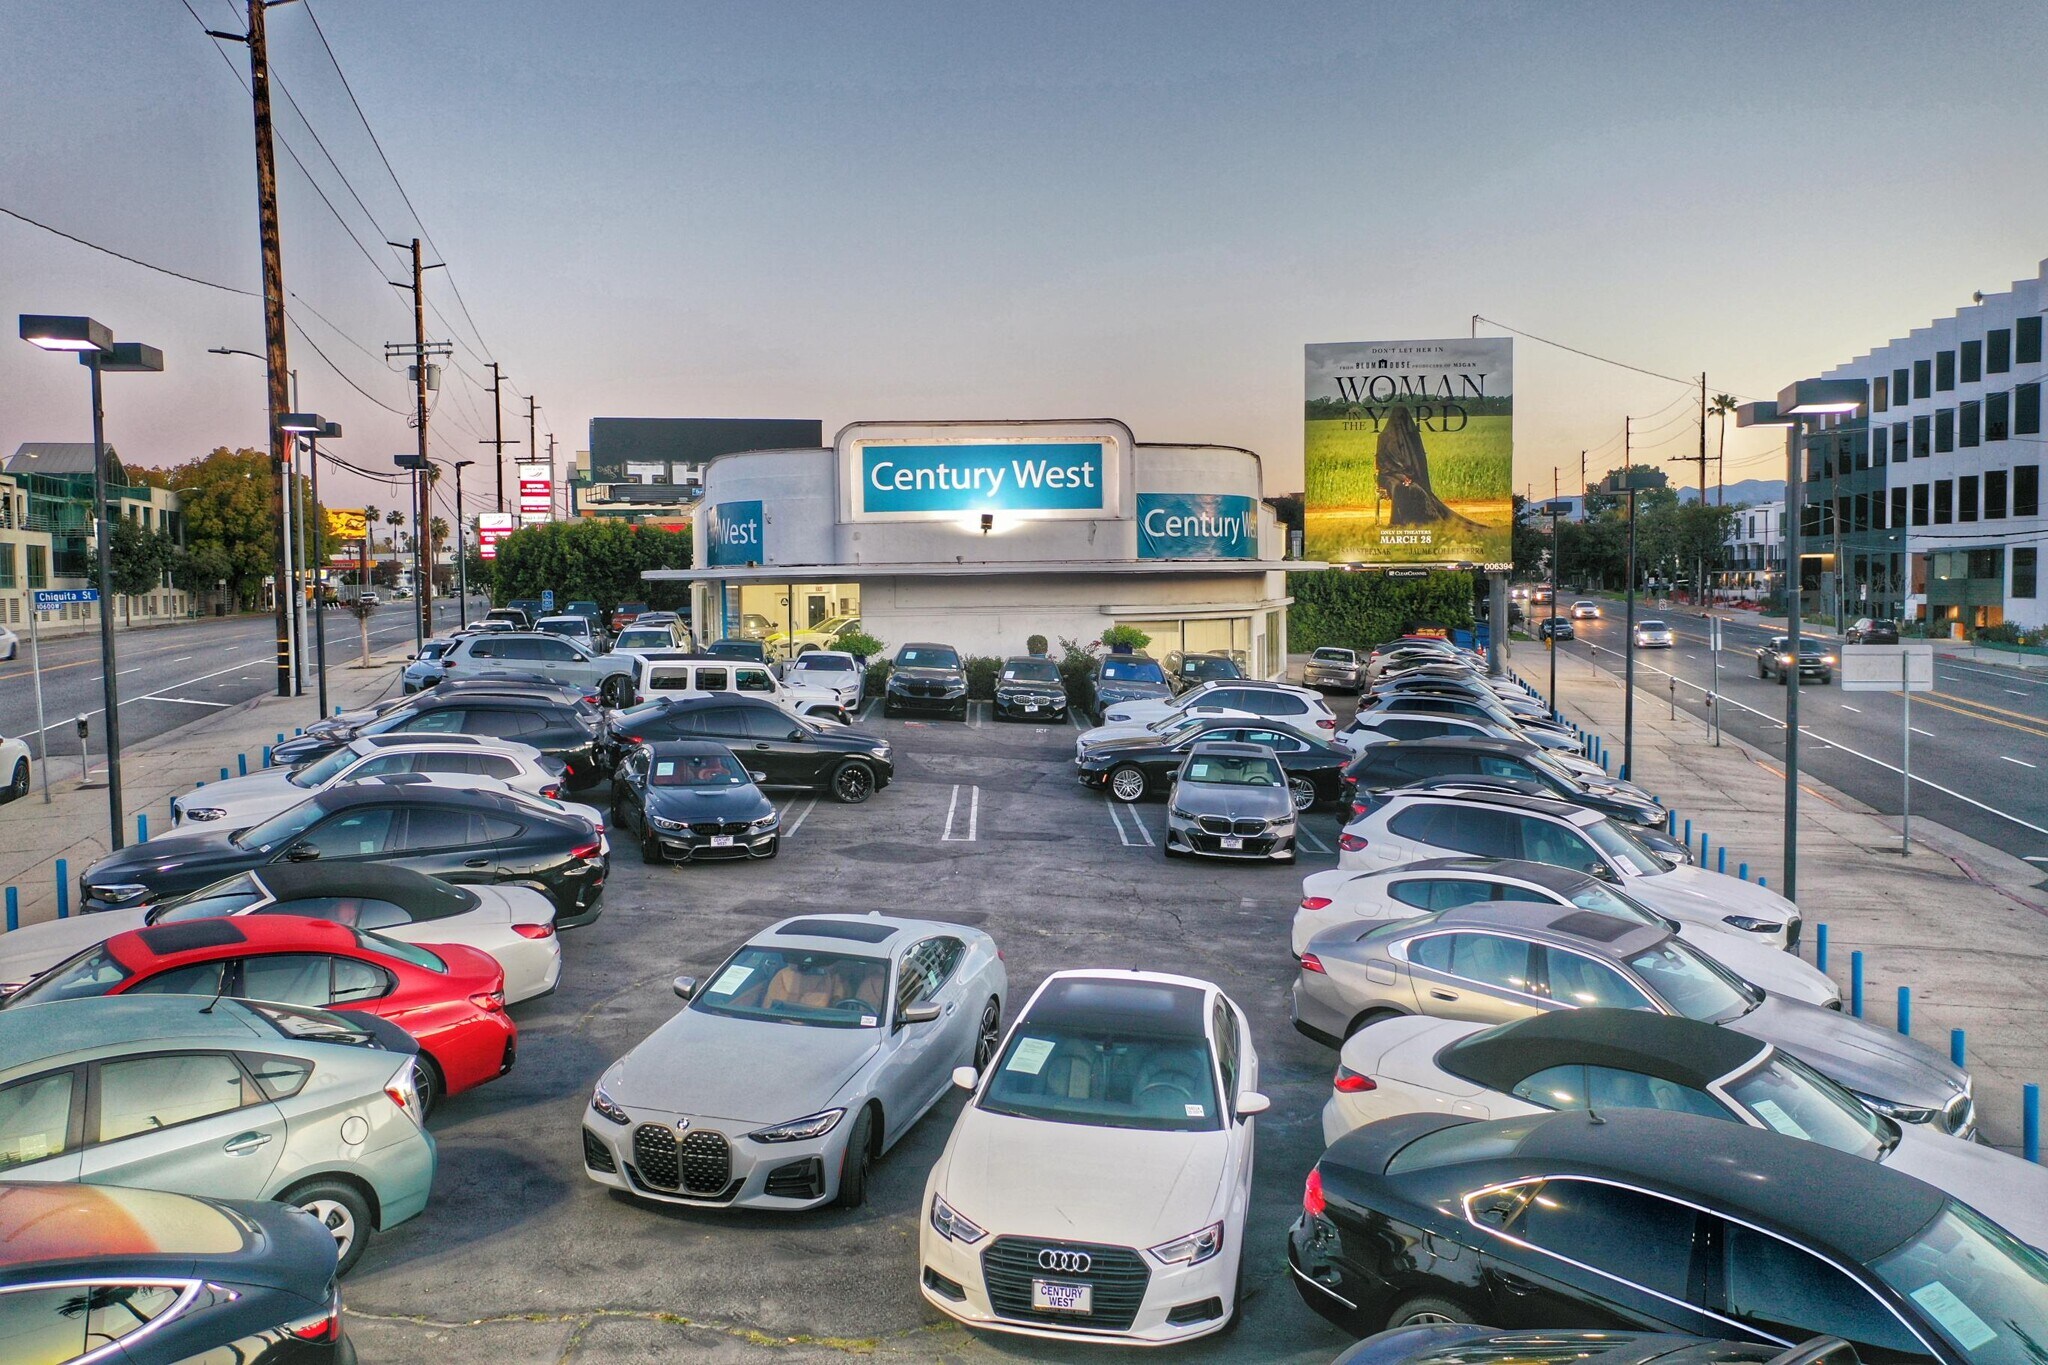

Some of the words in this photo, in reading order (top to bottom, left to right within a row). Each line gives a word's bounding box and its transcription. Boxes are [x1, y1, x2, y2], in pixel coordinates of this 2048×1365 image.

[1356, 359, 1410, 369] BLUMHOUSE
[1334, 373, 1487, 403] WOMAN
[1348, 411, 1360, 420] IN
[1343, 421, 1367, 430] THE
[871, 461, 1006, 498] Century
[1012, 459, 1095, 489] West
[717, 517, 758, 545] West
[1144, 508, 1240, 545] Century
[1380, 536, 1418, 544] MARCH
[1484, 562, 1513, 570] 006394
[39, 592, 77, 601] Chiquita
[82, 591, 92, 600] St
[1041, 1286, 1083, 1298] CENTURY
[1049, 1297, 1074, 1307] WEST
